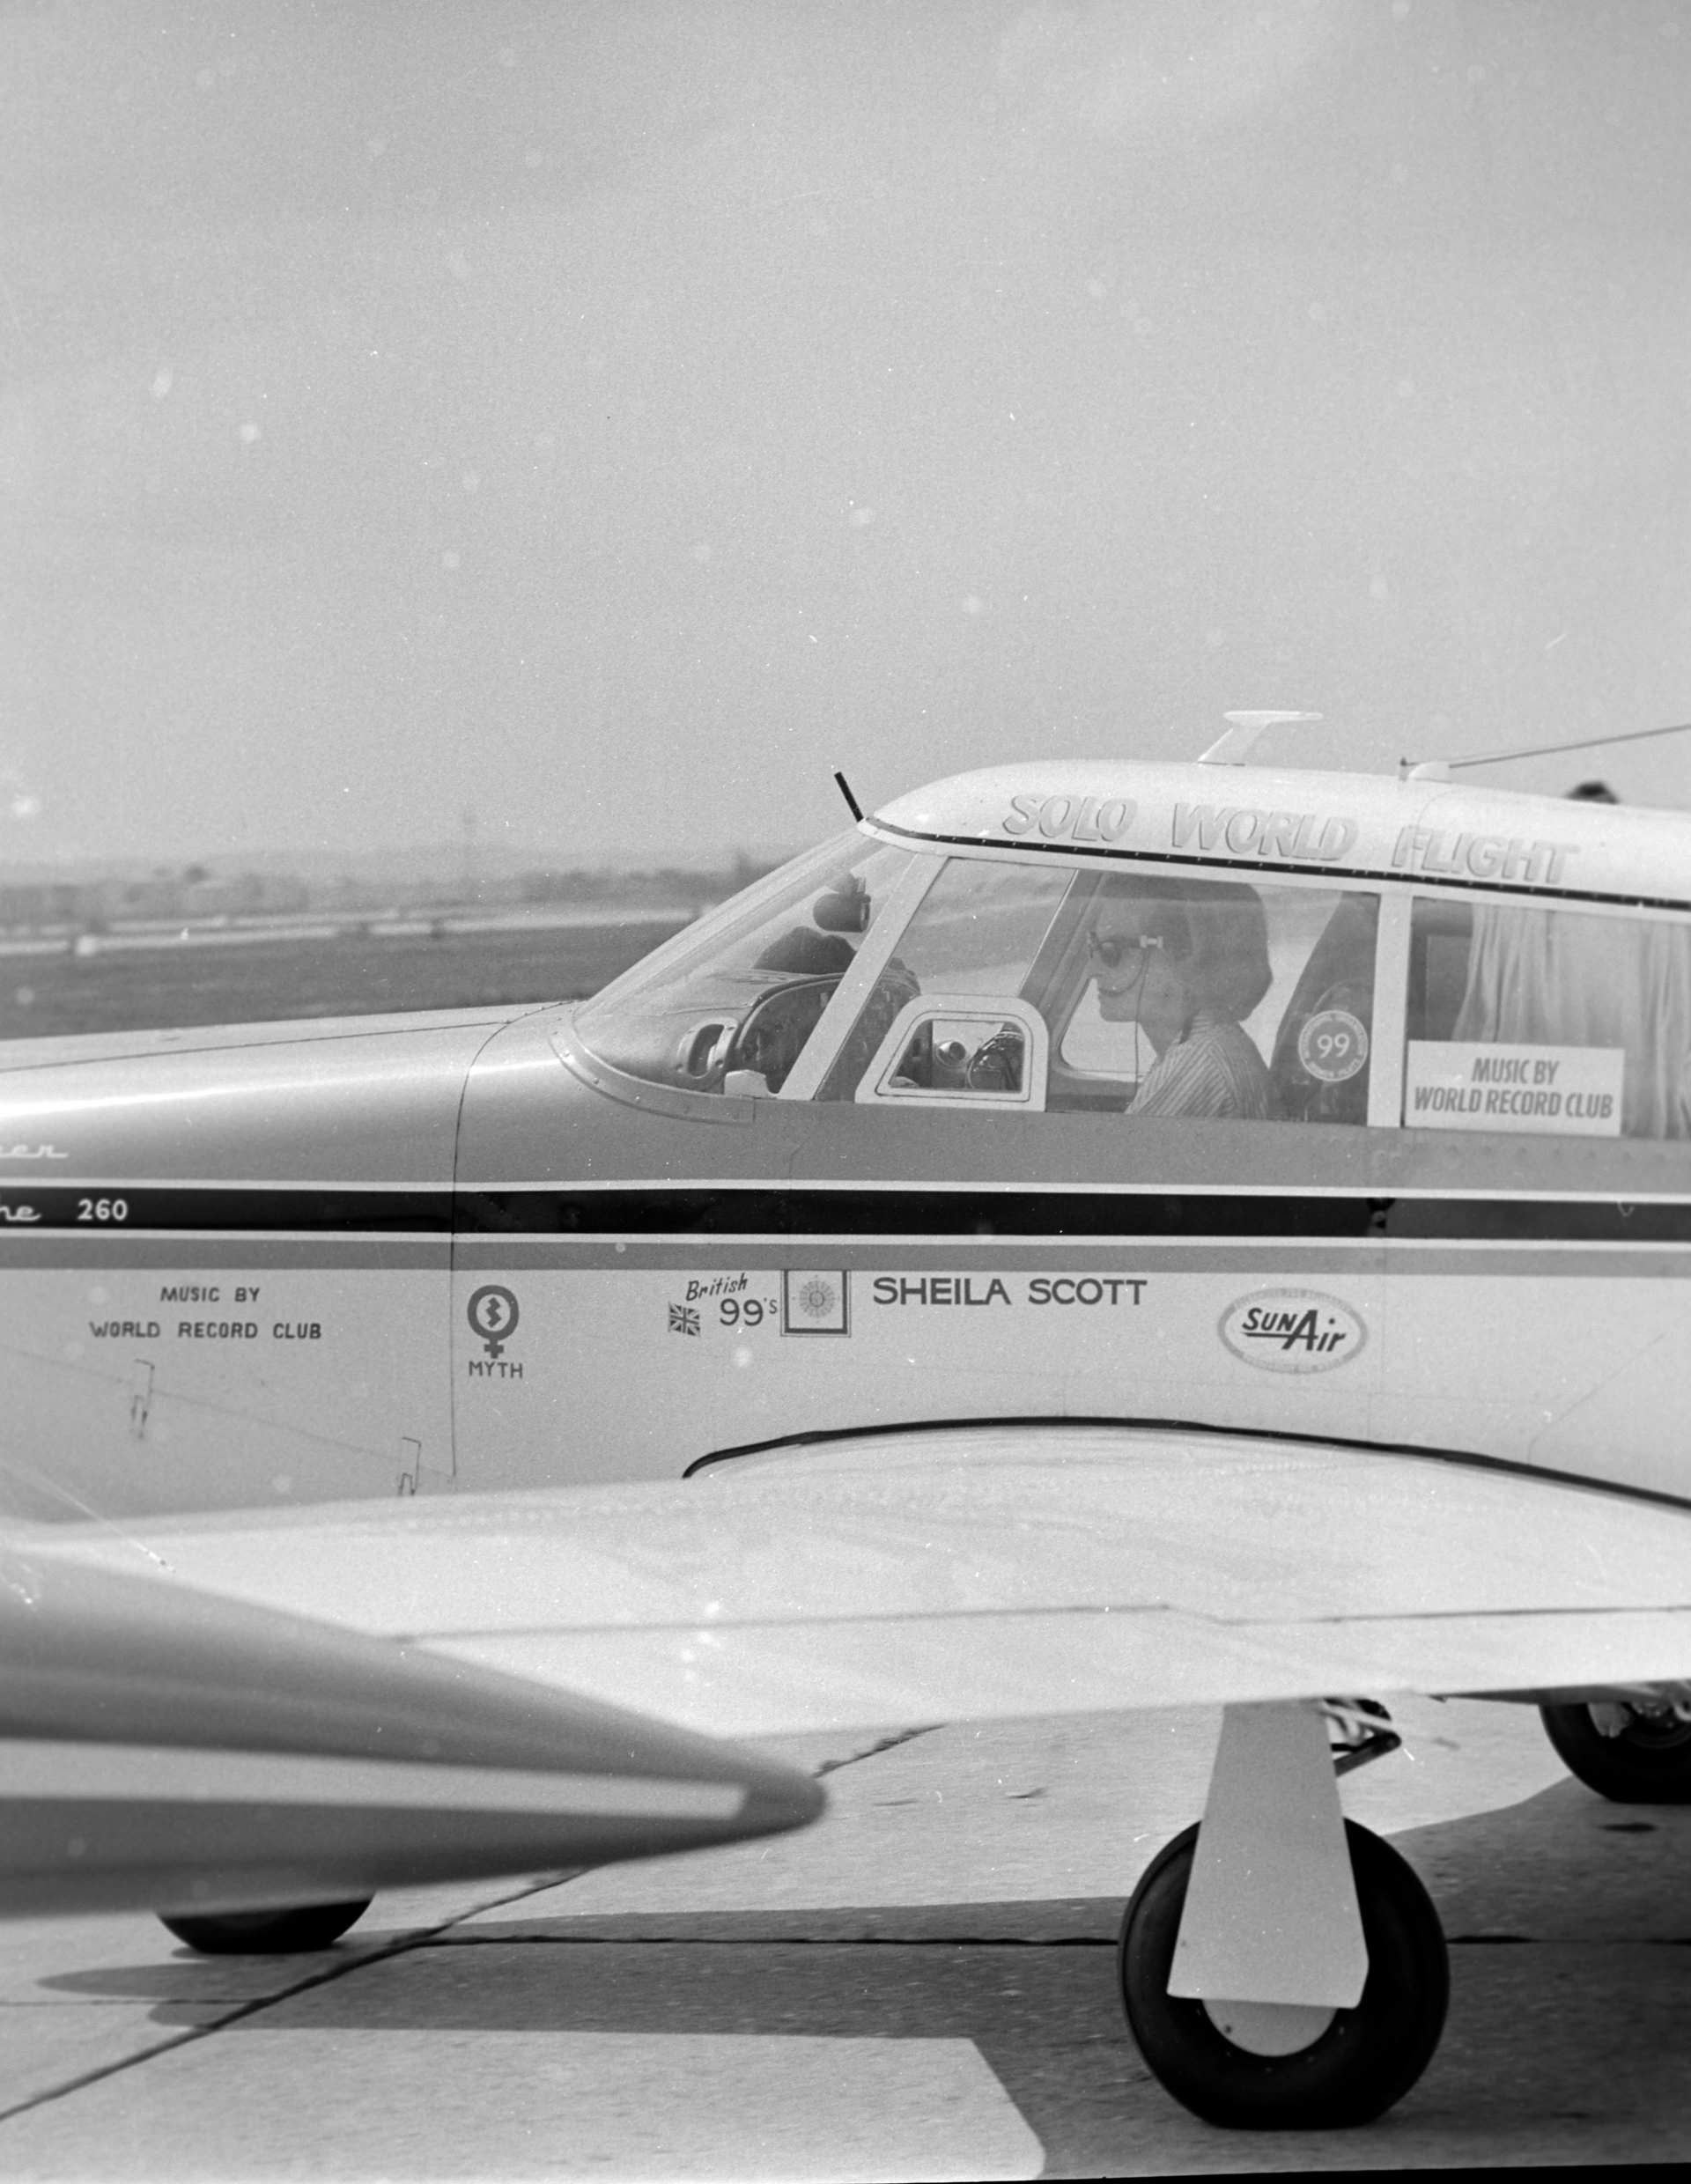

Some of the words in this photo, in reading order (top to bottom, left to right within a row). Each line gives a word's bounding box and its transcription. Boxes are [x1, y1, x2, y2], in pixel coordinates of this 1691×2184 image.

[1002, 793, 1138, 842] SOLO
[1171, 802, 1359, 861] WORLD
[1392, 824, 1580, 885] FLIGHT
[1317, 1033, 1349, 1059] 99
[1471, 1058, 1531, 1084] MUSIC
[1533, 1060, 1559, 1085] BY
[1414, 1087, 1481, 1113] WORLD
[1485, 1091, 1561, 1117] RECORD
[1565, 1093, 1613, 1119] CLUB
[78, 1198, 129, 1221] 260
[160, 1287, 220, 1302] MUSIC
[235, 1288, 261, 1302] BY
[685, 1272, 749, 1302] British
[873, 1277, 1012, 1306] SHEILA
[1028, 1279, 1148, 1306] SCOTT
[90, 1322, 161, 1339] WORLD
[178, 1323, 259, 1339] RECORD
[273, 1324, 321, 1339] CLUB
[469, 1361, 523, 1379] MYTH
